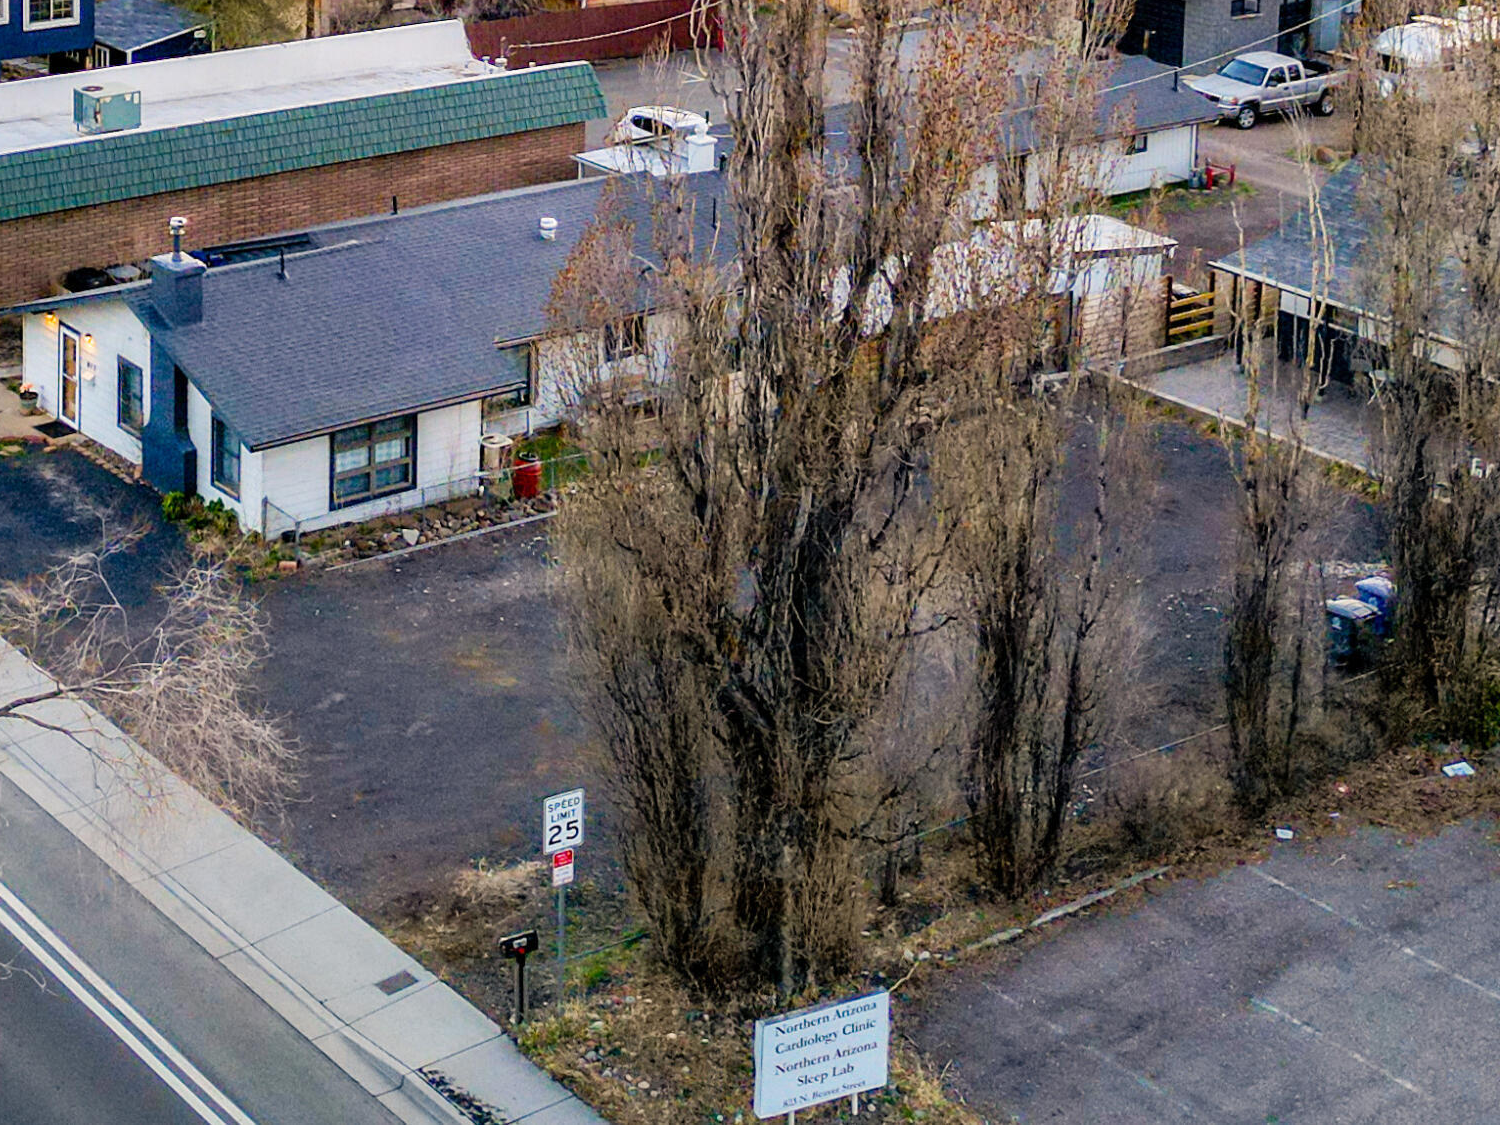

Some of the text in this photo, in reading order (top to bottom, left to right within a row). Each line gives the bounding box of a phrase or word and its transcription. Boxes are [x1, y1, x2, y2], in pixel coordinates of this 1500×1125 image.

[547, 797, 580, 813] SPEED
[551, 809, 576, 823] LIMIT
[548, 819, 580, 846] 25
[775, 1002, 877, 1037] Northern Arizona
[775, 1018, 877, 1054] Cardiology Clinic
[775, 1041, 878, 1075] Northern Arizona
[797, 1063, 854, 1086] Sleep Lab
[812, 1088, 839, 1100] Beaver
[842, 1081, 866, 1092] Street
